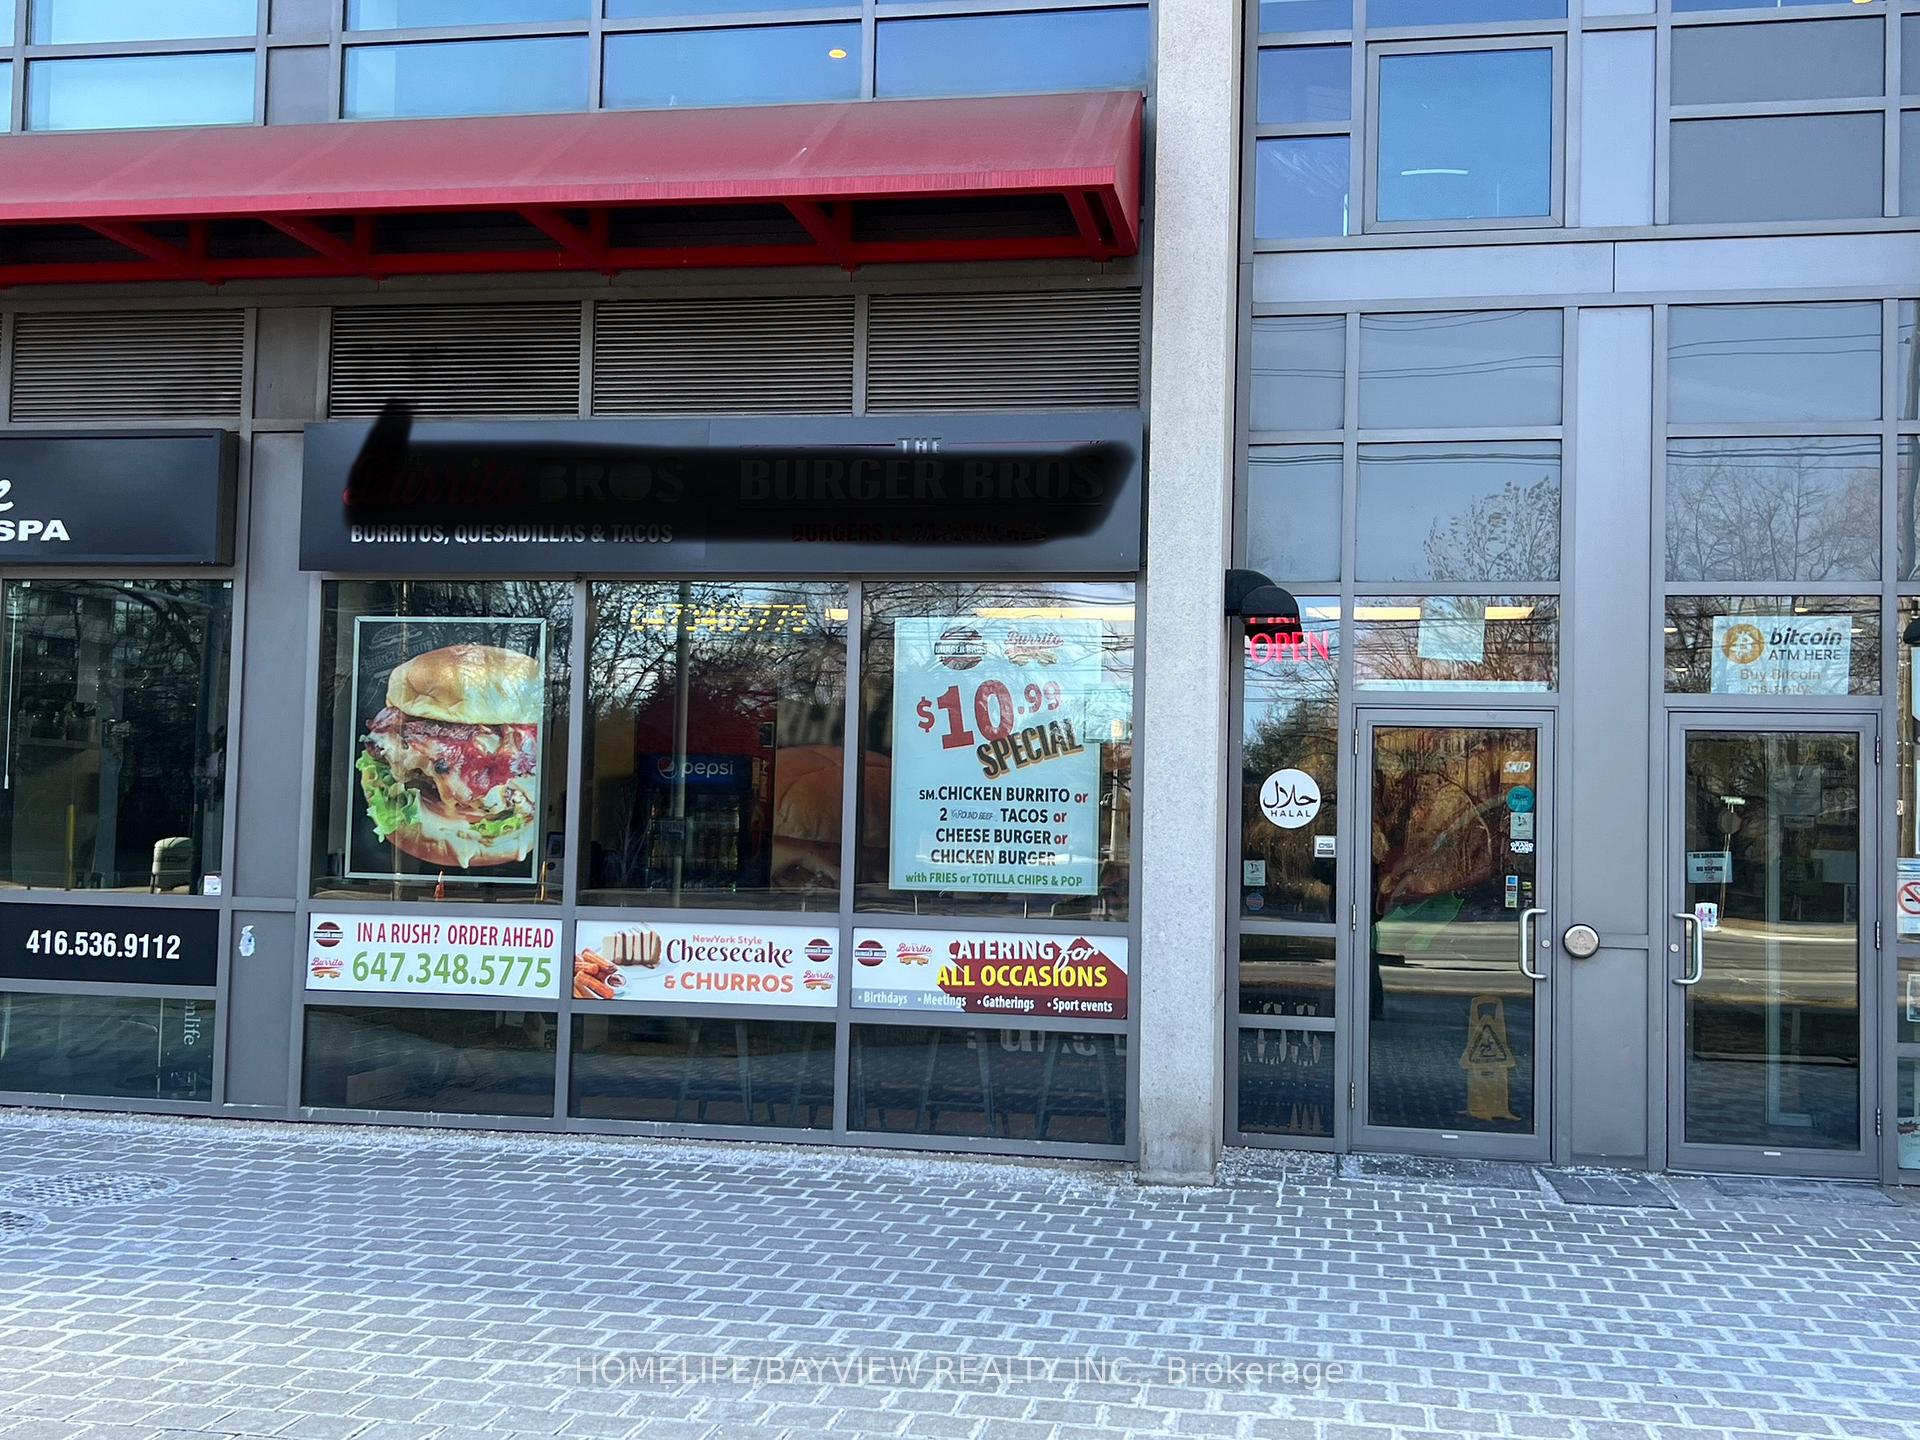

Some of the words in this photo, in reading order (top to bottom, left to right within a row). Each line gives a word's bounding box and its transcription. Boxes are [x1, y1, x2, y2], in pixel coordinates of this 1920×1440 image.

[0, 519, 71, 541] SPA
[351, 524, 451, 545] BURRITOS,
[454, 524, 586, 543] QUESADILLAS
[590, 524, 606, 543] &
[612, 524, 673, 543] TACOS
[1769, 627, 1842, 646] bitcoin
[1250, 631, 1330, 664] OPEN
[1768, 650, 1800, 661] ATM
[1804, 650, 1842, 661] HERE
[976, 718, 1084, 779] SPECIAL
[682, 760, 734, 778] pepsi
[1504, 761, 1531, 773] SKIP
[1006, 787, 1070, 803] BURRITO
[1074, 792, 1088, 803] or
[1263, 780, 1318, 809] حلال
[939, 807, 948, 821] 2
[1000, 808, 1048, 823] TACOS
[1053, 811, 1067, 823] or
[1270, 809, 1312, 818] HALAL
[936, 828, 990, 843] CHEESE
[994, 829, 1051, 844] BURGER
[1054, 834, 1068, 845] or
[931, 849, 994, 864] CHICKEN
[998, 850, 1056, 866] BURGER
[905, 872, 927, 883] with
[929, 872, 957, 883] FRIES
[960, 876, 970, 884] or
[973, 873, 1015, 885] TOTILLA
[1017, 874, 1048, 886] CHIPS
[1051, 876, 1058, 886] &
[1061, 876, 1083, 887] POP
[26, 930, 181, 960] 416.536.9112
[357, 922, 373, 943] IN
[377, 923, 387, 943] A
[391, 923, 440, 945] RUSH?
[447, 925, 499, 946] ORDER
[502, 927, 555, 948] AHEAD
[738, 937, 763, 946] Style
[667, 938, 793, 969] Cheesecake
[949, 940, 1053, 960] CATERING
[1054, 946, 1100, 972] for
[352, 951, 552, 988] 647.348.5775
[937, 964, 975, 986] ALL
[981, 965, 1108, 988] OCCASIONS
[664, 975, 677, 989] &
[680, 971, 794, 993] CHURROS
[864, 991, 908, 1004] Birthdays
[923, 993, 967, 1007] Meetings
[983, 995, 1035, 1011] Gatherings
[1053, 998, 1079, 1013] Sport
[1081, 1001, 1113, 1012] events
